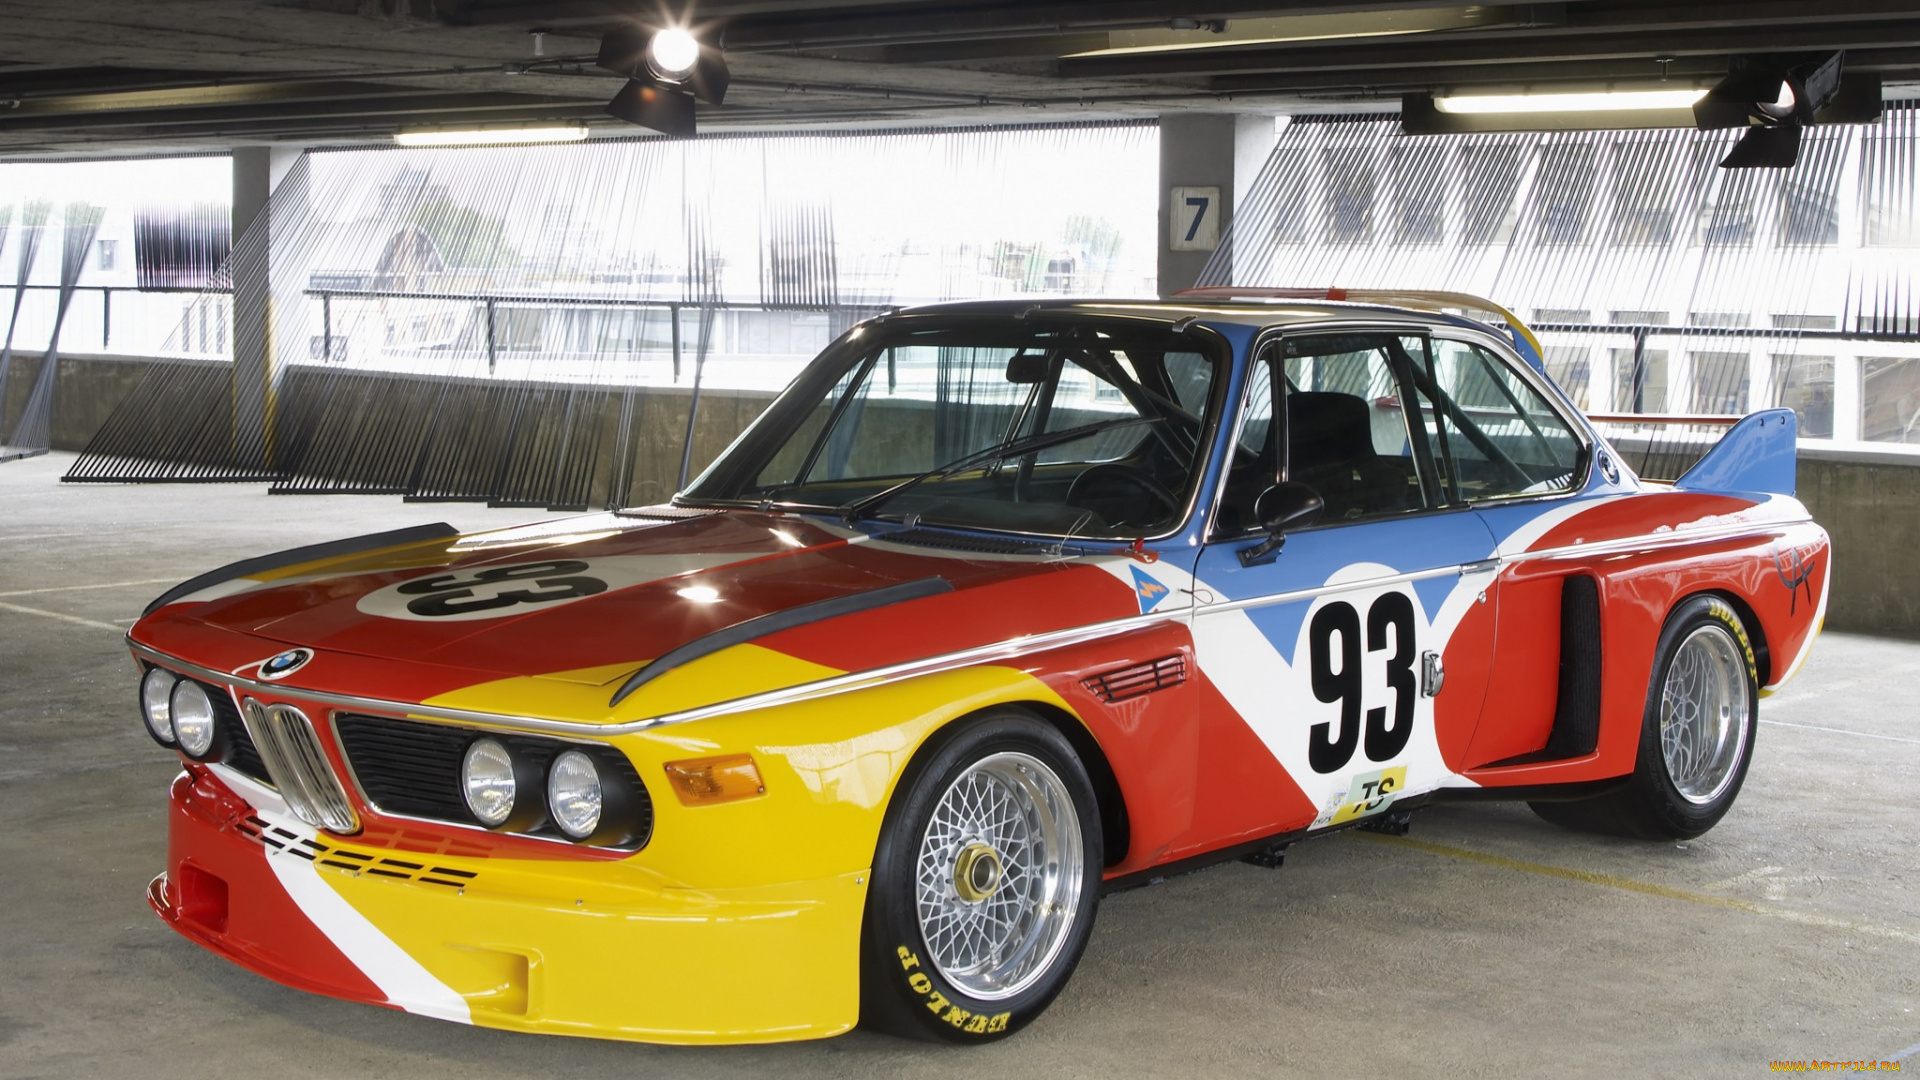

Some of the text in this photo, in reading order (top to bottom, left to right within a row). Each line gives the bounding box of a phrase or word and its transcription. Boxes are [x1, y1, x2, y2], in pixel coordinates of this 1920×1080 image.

[1185, 197, 1209, 241] 7
[397, 560, 609, 617] 93
[1308, 591, 1417, 775] 93
[897, 945, 1011, 1034] DUNLOP
